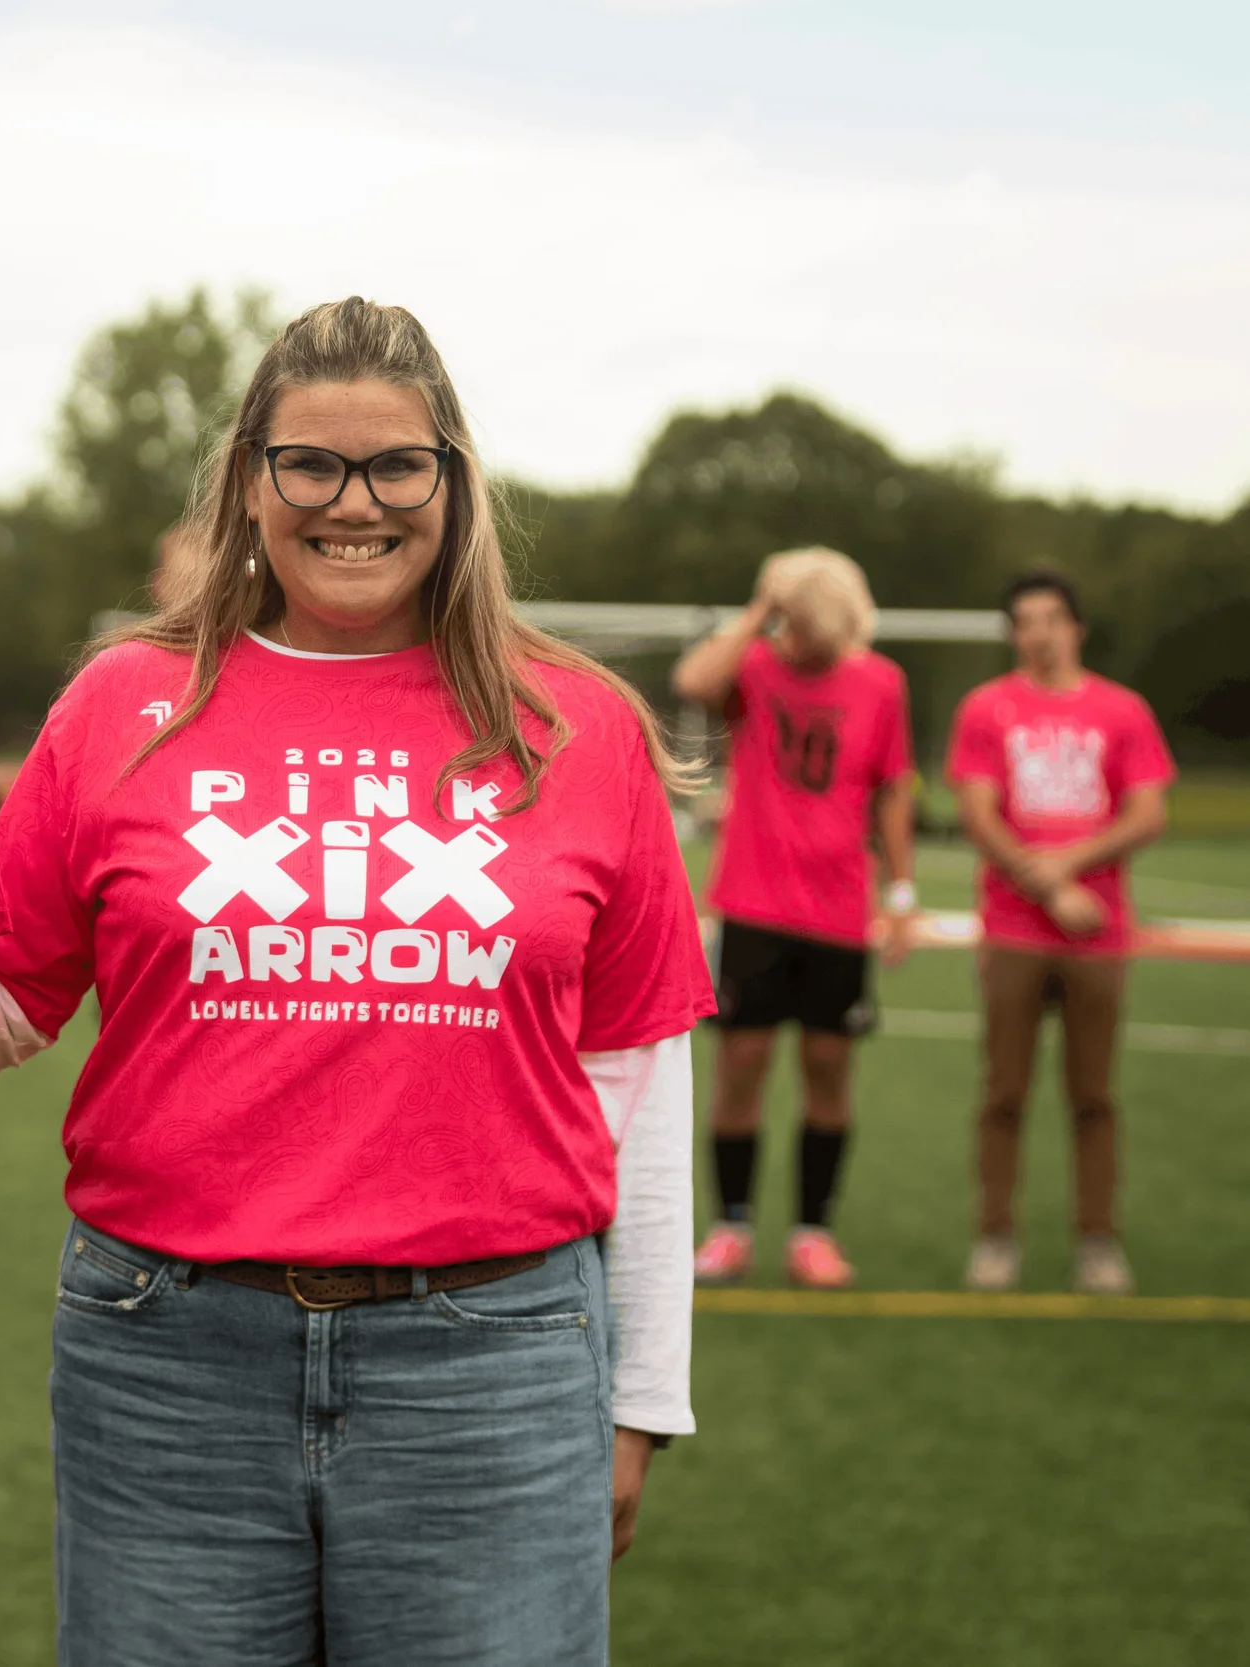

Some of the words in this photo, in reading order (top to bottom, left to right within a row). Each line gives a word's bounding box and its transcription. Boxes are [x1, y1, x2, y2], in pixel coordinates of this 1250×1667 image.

[285, 748, 410, 767] 2026
[188, 925, 516, 989] ARROW
[190, 1001, 279, 1020] LOWELL
[377, 1003, 500, 1029] TOGETHER
